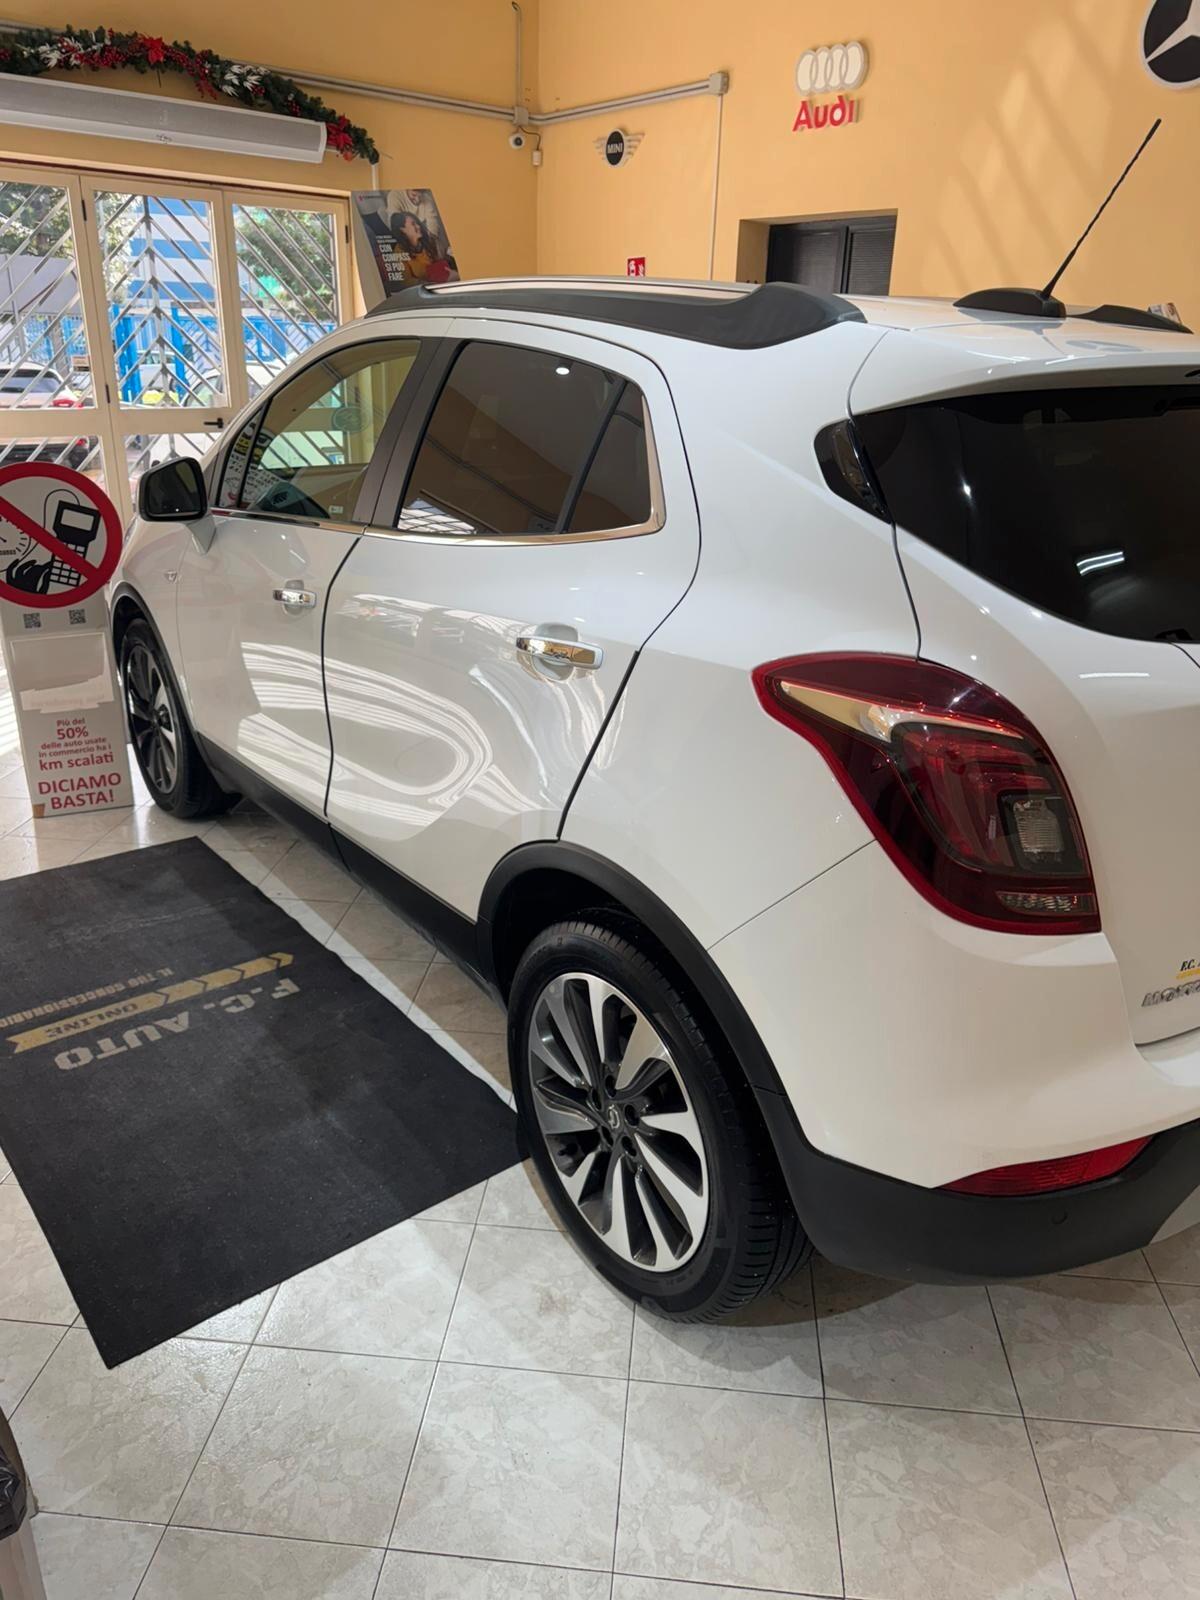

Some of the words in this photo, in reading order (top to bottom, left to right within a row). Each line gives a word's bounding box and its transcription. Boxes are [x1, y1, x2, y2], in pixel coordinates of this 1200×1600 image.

[792, 95, 857, 132] Audi
[606, 143, 623, 154] MINI
[380, 244, 393, 253] CON
[383, 253, 411, 262] COMPASS
[388, 272, 404, 281] FARE
[72, 717, 86, 725] del
[57, 726, 89, 740] 50%
[41, 741, 62, 750] delle
[64, 739, 83, 747] auto
[85, 737, 107, 745] usate
[49, 747, 95, 758] commercio
[39, 759, 63, 771] km
[67, 751, 114, 768] scalati
[38, 772, 122, 795] DICIAMO
[51, 789, 115, 810] BASTA!
[127, 972, 157, 988] TUO
[46, 1002, 138, 1038] ONLINE
[54, 1010, 192, 1071] AUTO
